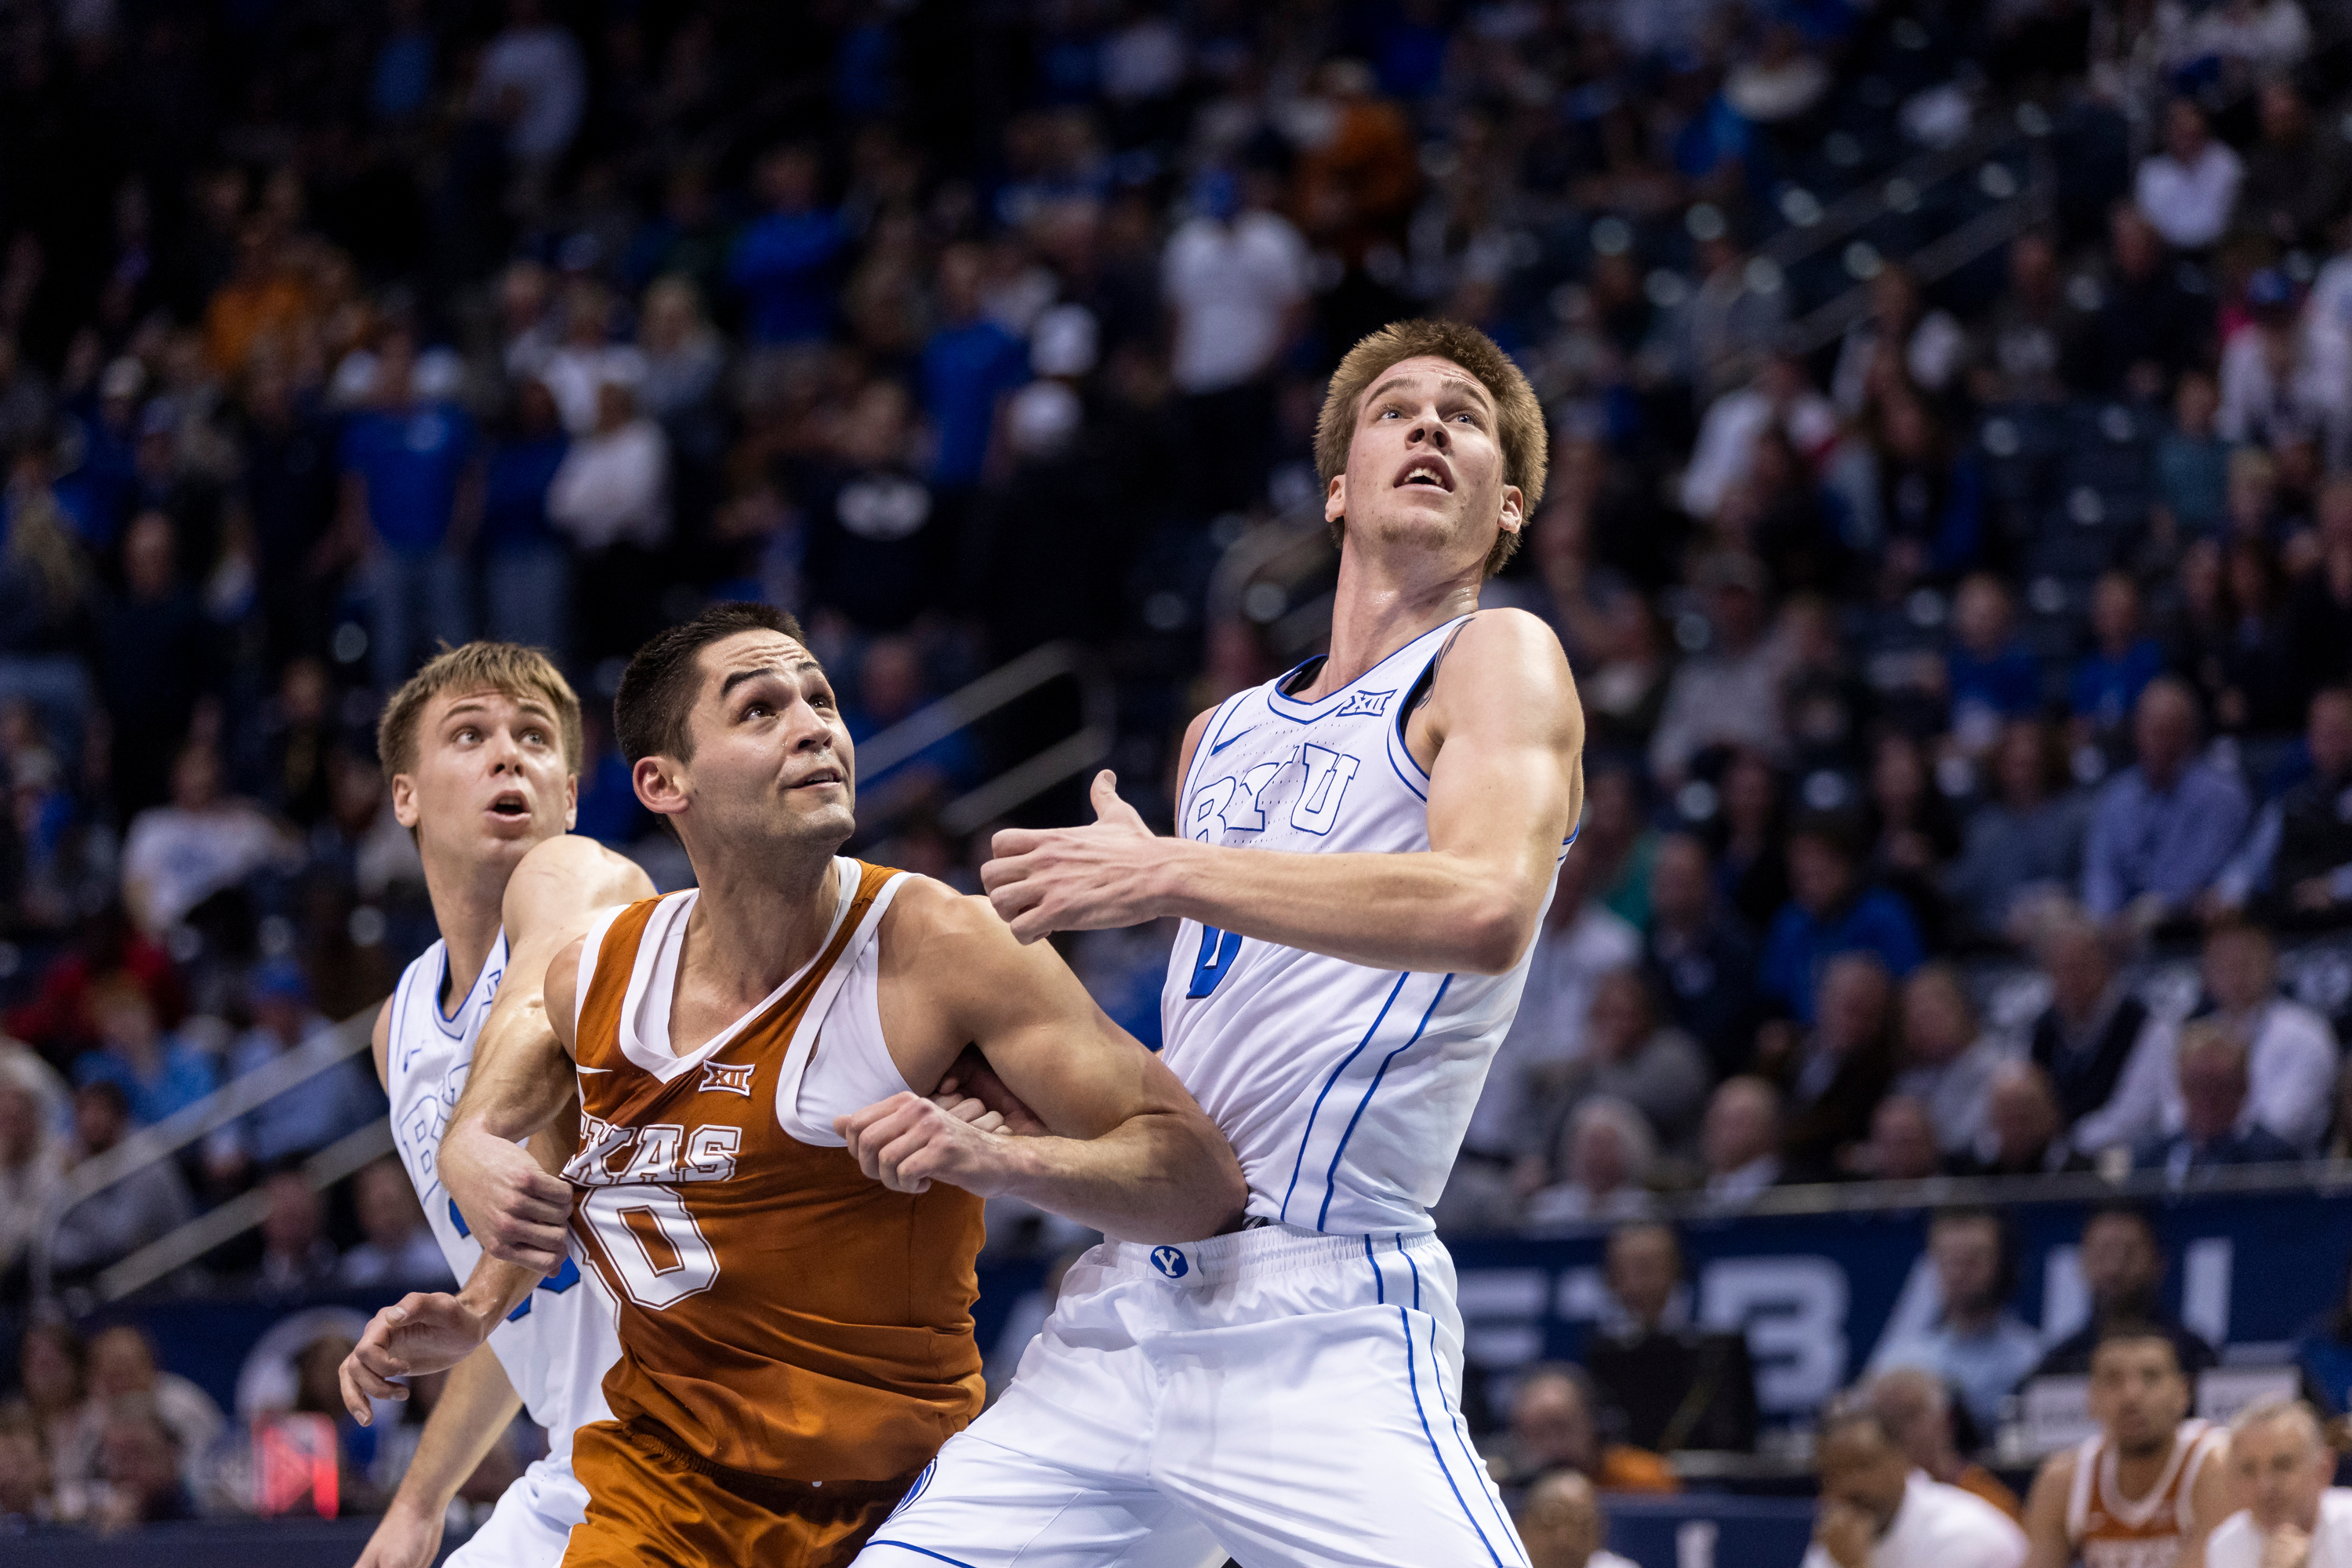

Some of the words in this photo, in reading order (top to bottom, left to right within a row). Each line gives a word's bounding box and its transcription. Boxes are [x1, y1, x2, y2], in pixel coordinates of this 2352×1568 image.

[1335, 688, 1397, 717] XII
[1185, 742, 1360, 844] BYU
[699, 1060, 755, 1096] XII
[559, 1109, 742, 1186] XAS
[1154, 1248, 1181, 1276] Y
